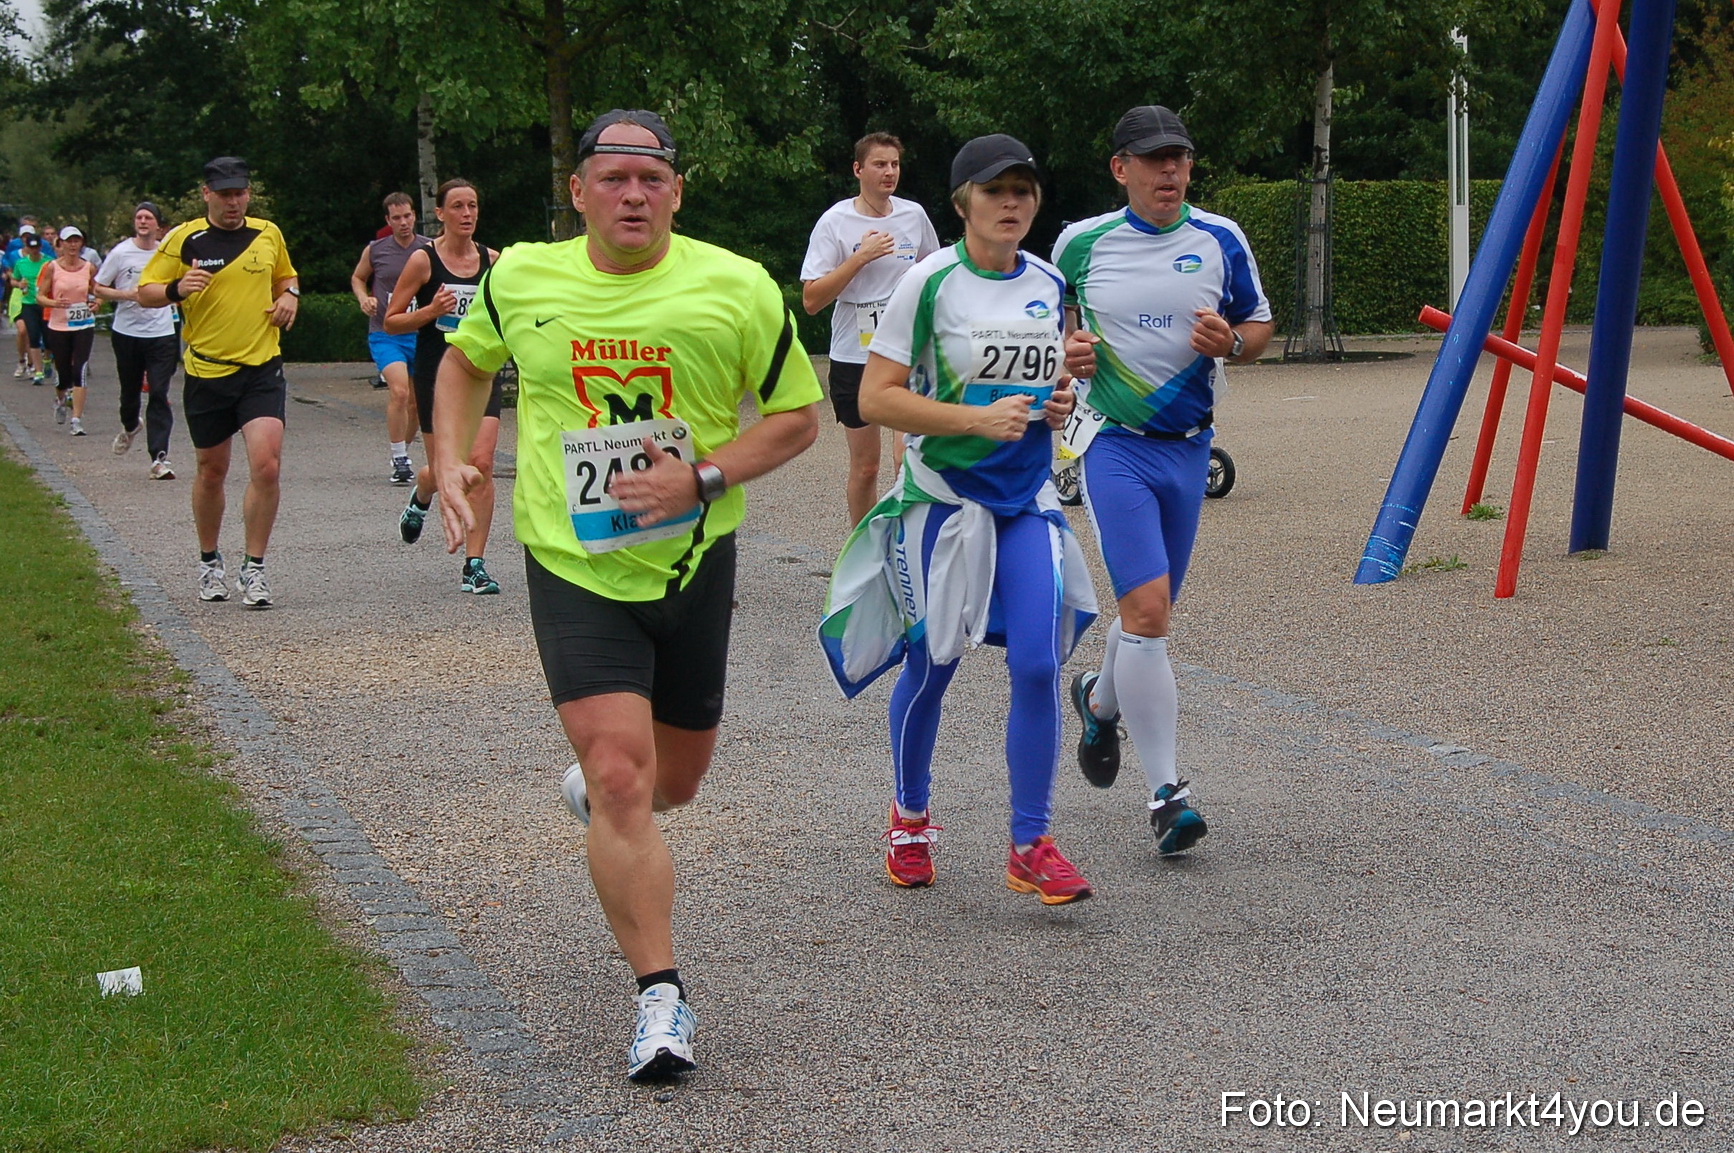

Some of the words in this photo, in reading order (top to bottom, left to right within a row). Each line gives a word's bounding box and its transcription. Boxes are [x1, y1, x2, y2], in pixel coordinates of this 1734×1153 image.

[1138, 314, 1173, 328] Rolf
[570, 338, 673, 362] Müller
[978, 345, 1057, 381] 2796
[564, 441, 602, 455] PARTL
[604, 430, 667, 451] Neumkt
